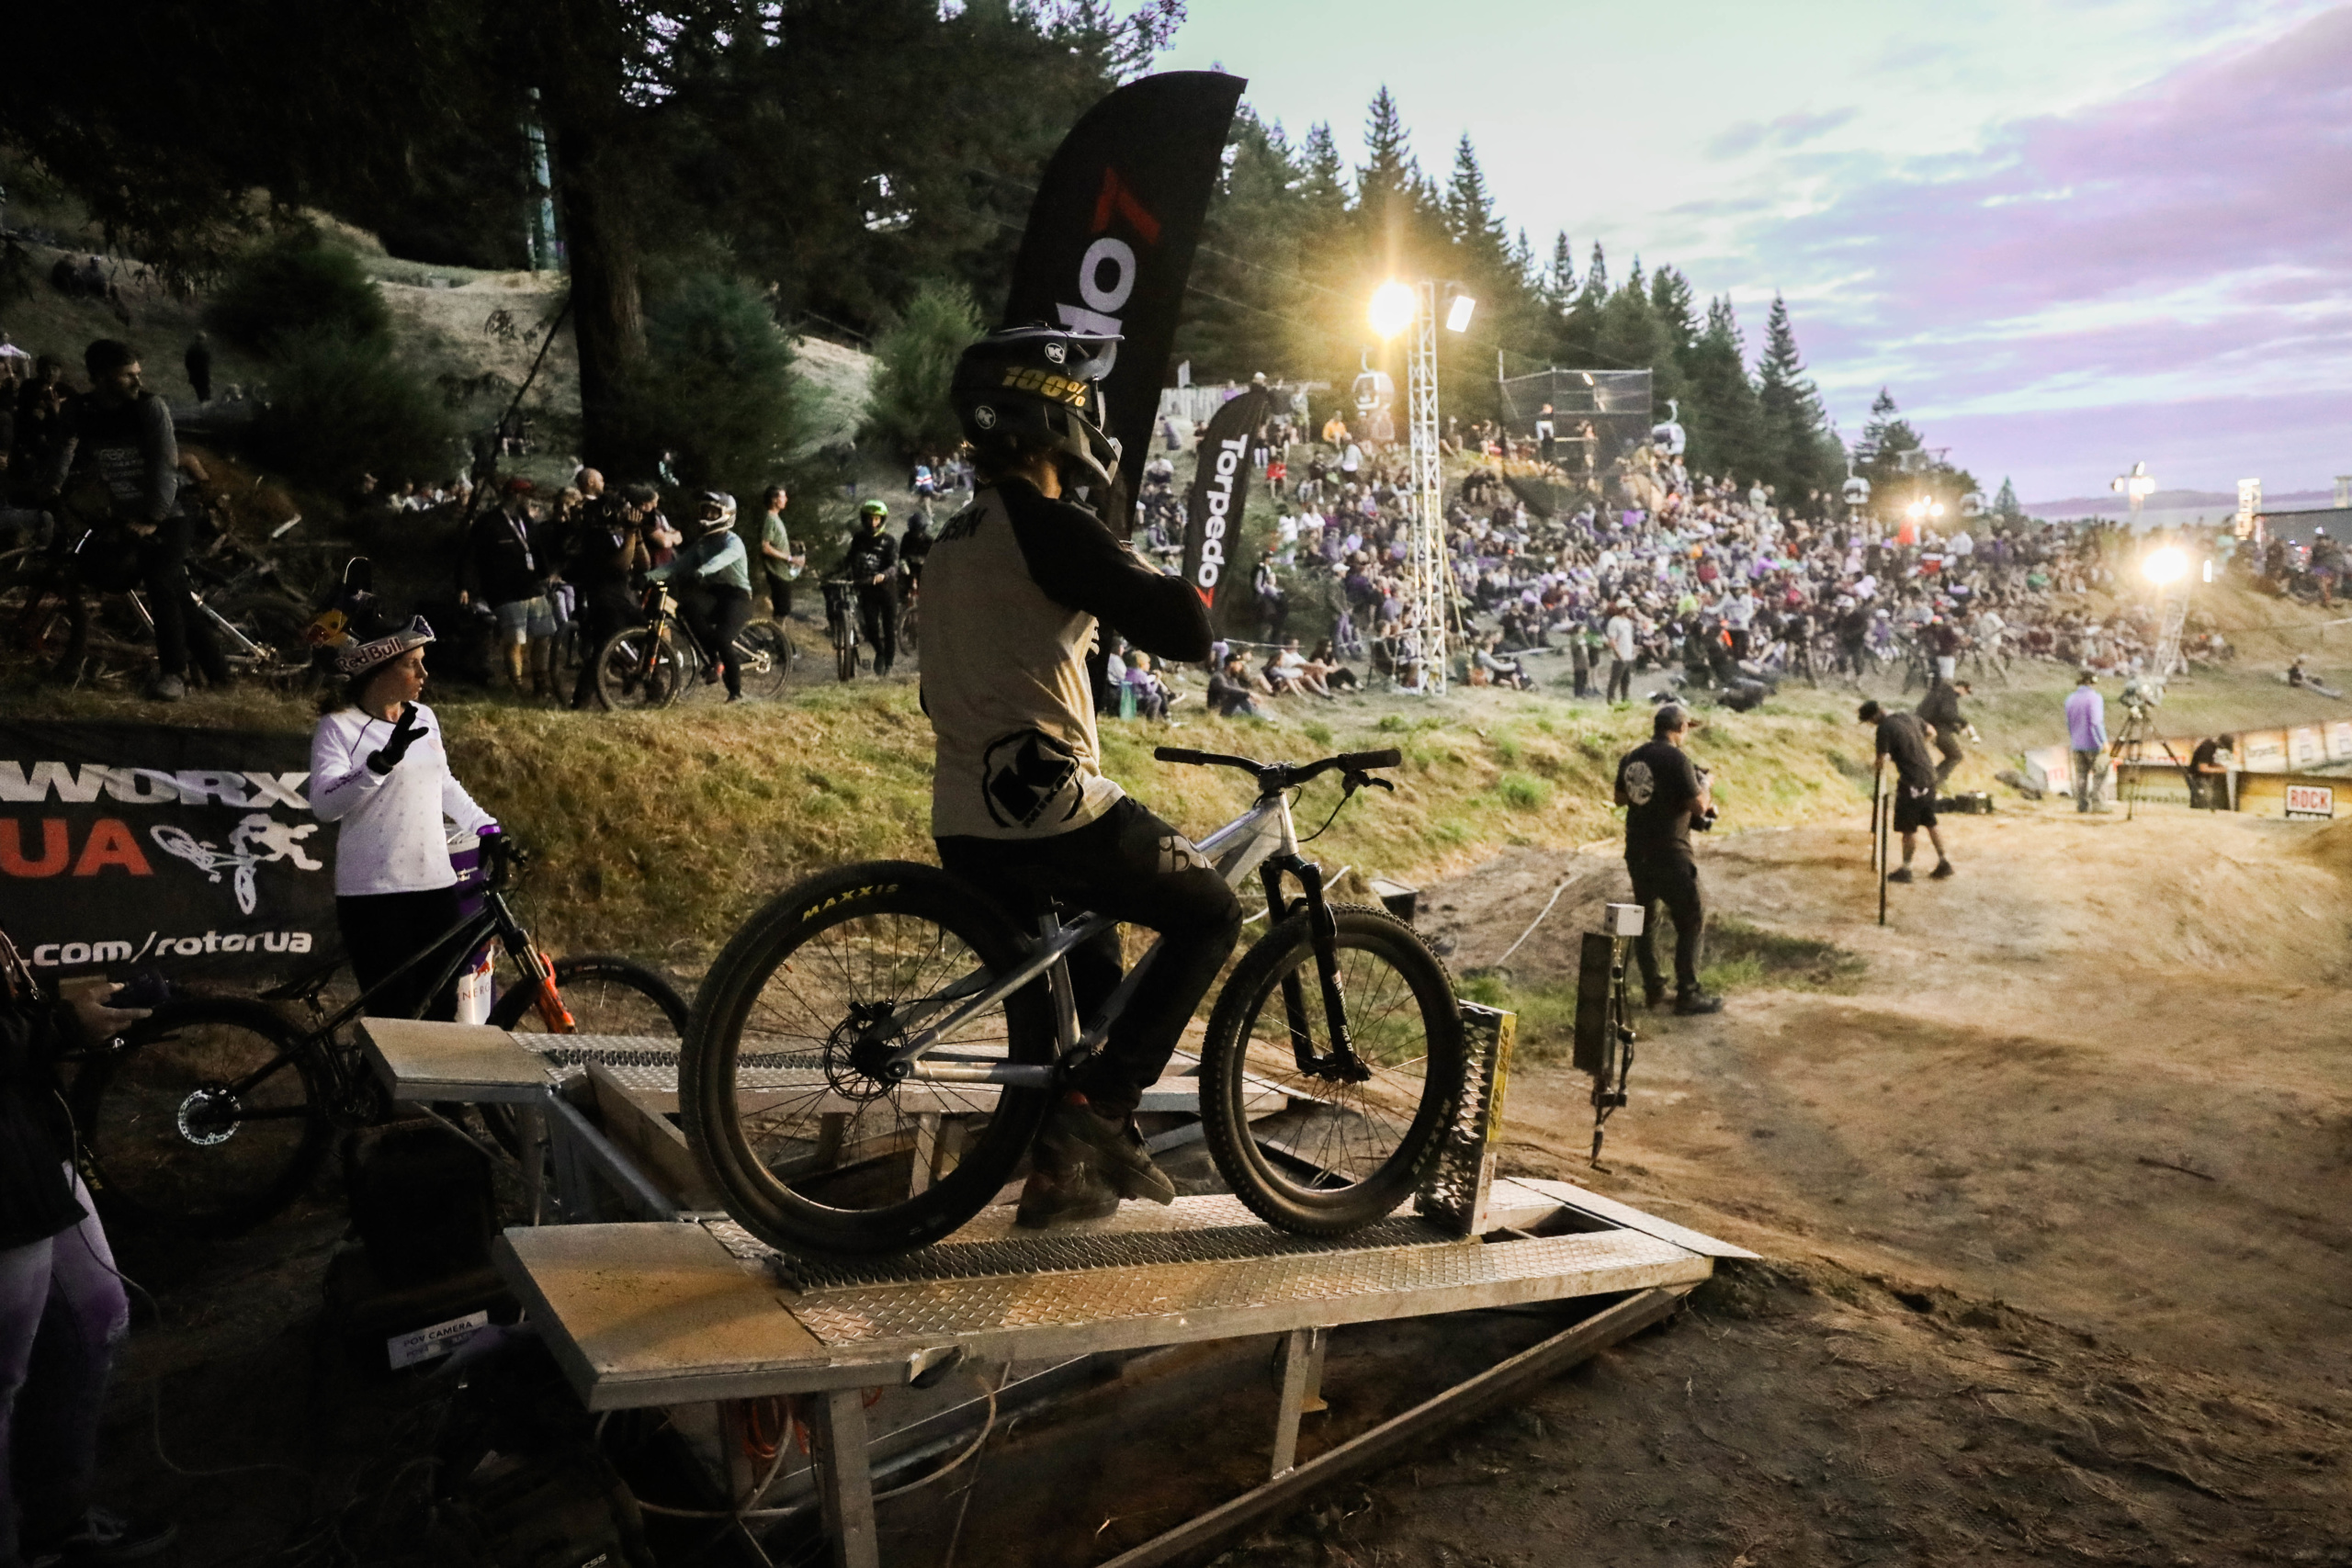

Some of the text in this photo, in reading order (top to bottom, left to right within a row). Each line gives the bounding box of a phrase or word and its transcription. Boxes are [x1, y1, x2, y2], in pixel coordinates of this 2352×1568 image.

[1001, 367, 1087, 408] 100%
[336, 637, 403, 671] Red Bull
[2290, 788, 2329, 809] ROCK
[802, 884, 899, 921] MAXXIS
[403, 1335, 425, 1348] POV
[428, 1321, 473, 1340] CAMERA
